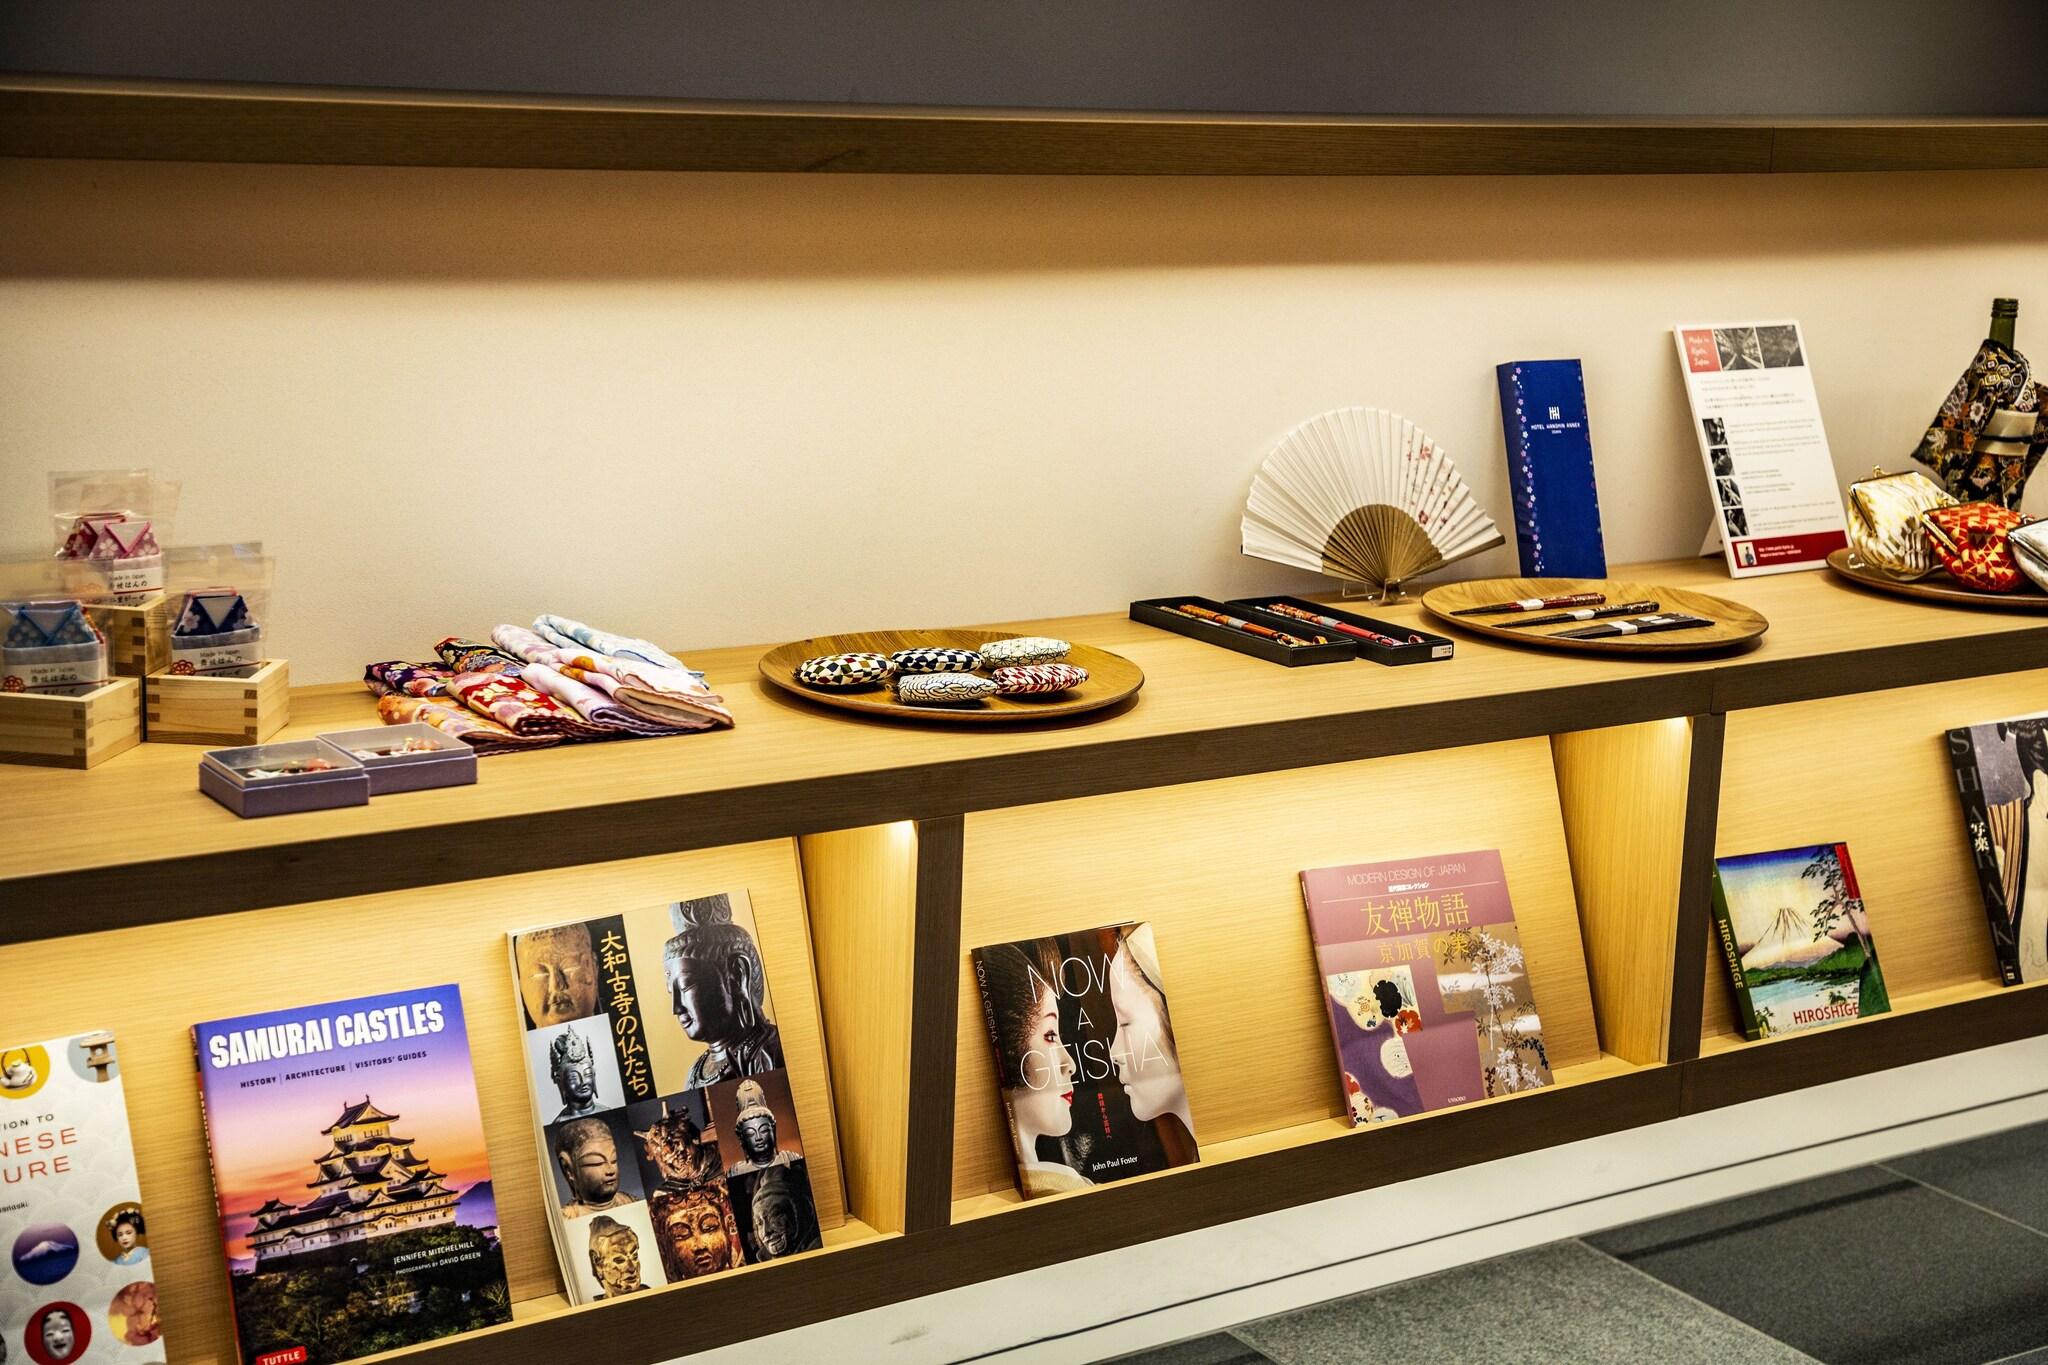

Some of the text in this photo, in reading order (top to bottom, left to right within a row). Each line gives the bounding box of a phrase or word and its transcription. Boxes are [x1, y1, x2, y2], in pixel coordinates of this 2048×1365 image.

[1970, 821, 1990, 852] 写楽
[1346, 863, 1466, 885] MODERN DESIGN OF JAPAN
[1360, 892, 1470, 936] 友禅物語
[1718, 919, 1744, 989] HIROSHIGE
[1027, 950, 1125, 1004] NOW
[600, 930, 649, 1096] 大和古寺の仏たち
[976, 960, 988, 987] NOW
[983, 1000, 999, 1043] GEISHA
[1793, 1002, 1859, 1025] HIROSHIGE
[208, 1017, 334, 1069] SAMURAI
[335, 1000, 446, 1048] CASTLES
[1077, 1007, 1095, 1031] A
[240, 1076, 277, 1088] HISTORY
[285, 1064, 347, 1081] ARCHITECTURE
[397, 1050, 428, 1062] GUIDES
[1020, 1031, 1169, 1091] GEISHA
[0, 1113, 54, 1131] ION TO
[1092, 1156, 1138, 1172] John Paul Foster
[393, 1241, 474, 1264] JENNIFER MITCHELHILL
[395, 1263, 431, 1275] PHOTOGRAPHS
[439, 1256, 459, 1266] DAVID
[460, 1251, 481, 1262] GREEN
[262, 1350, 300, 1365] TUTTLE
